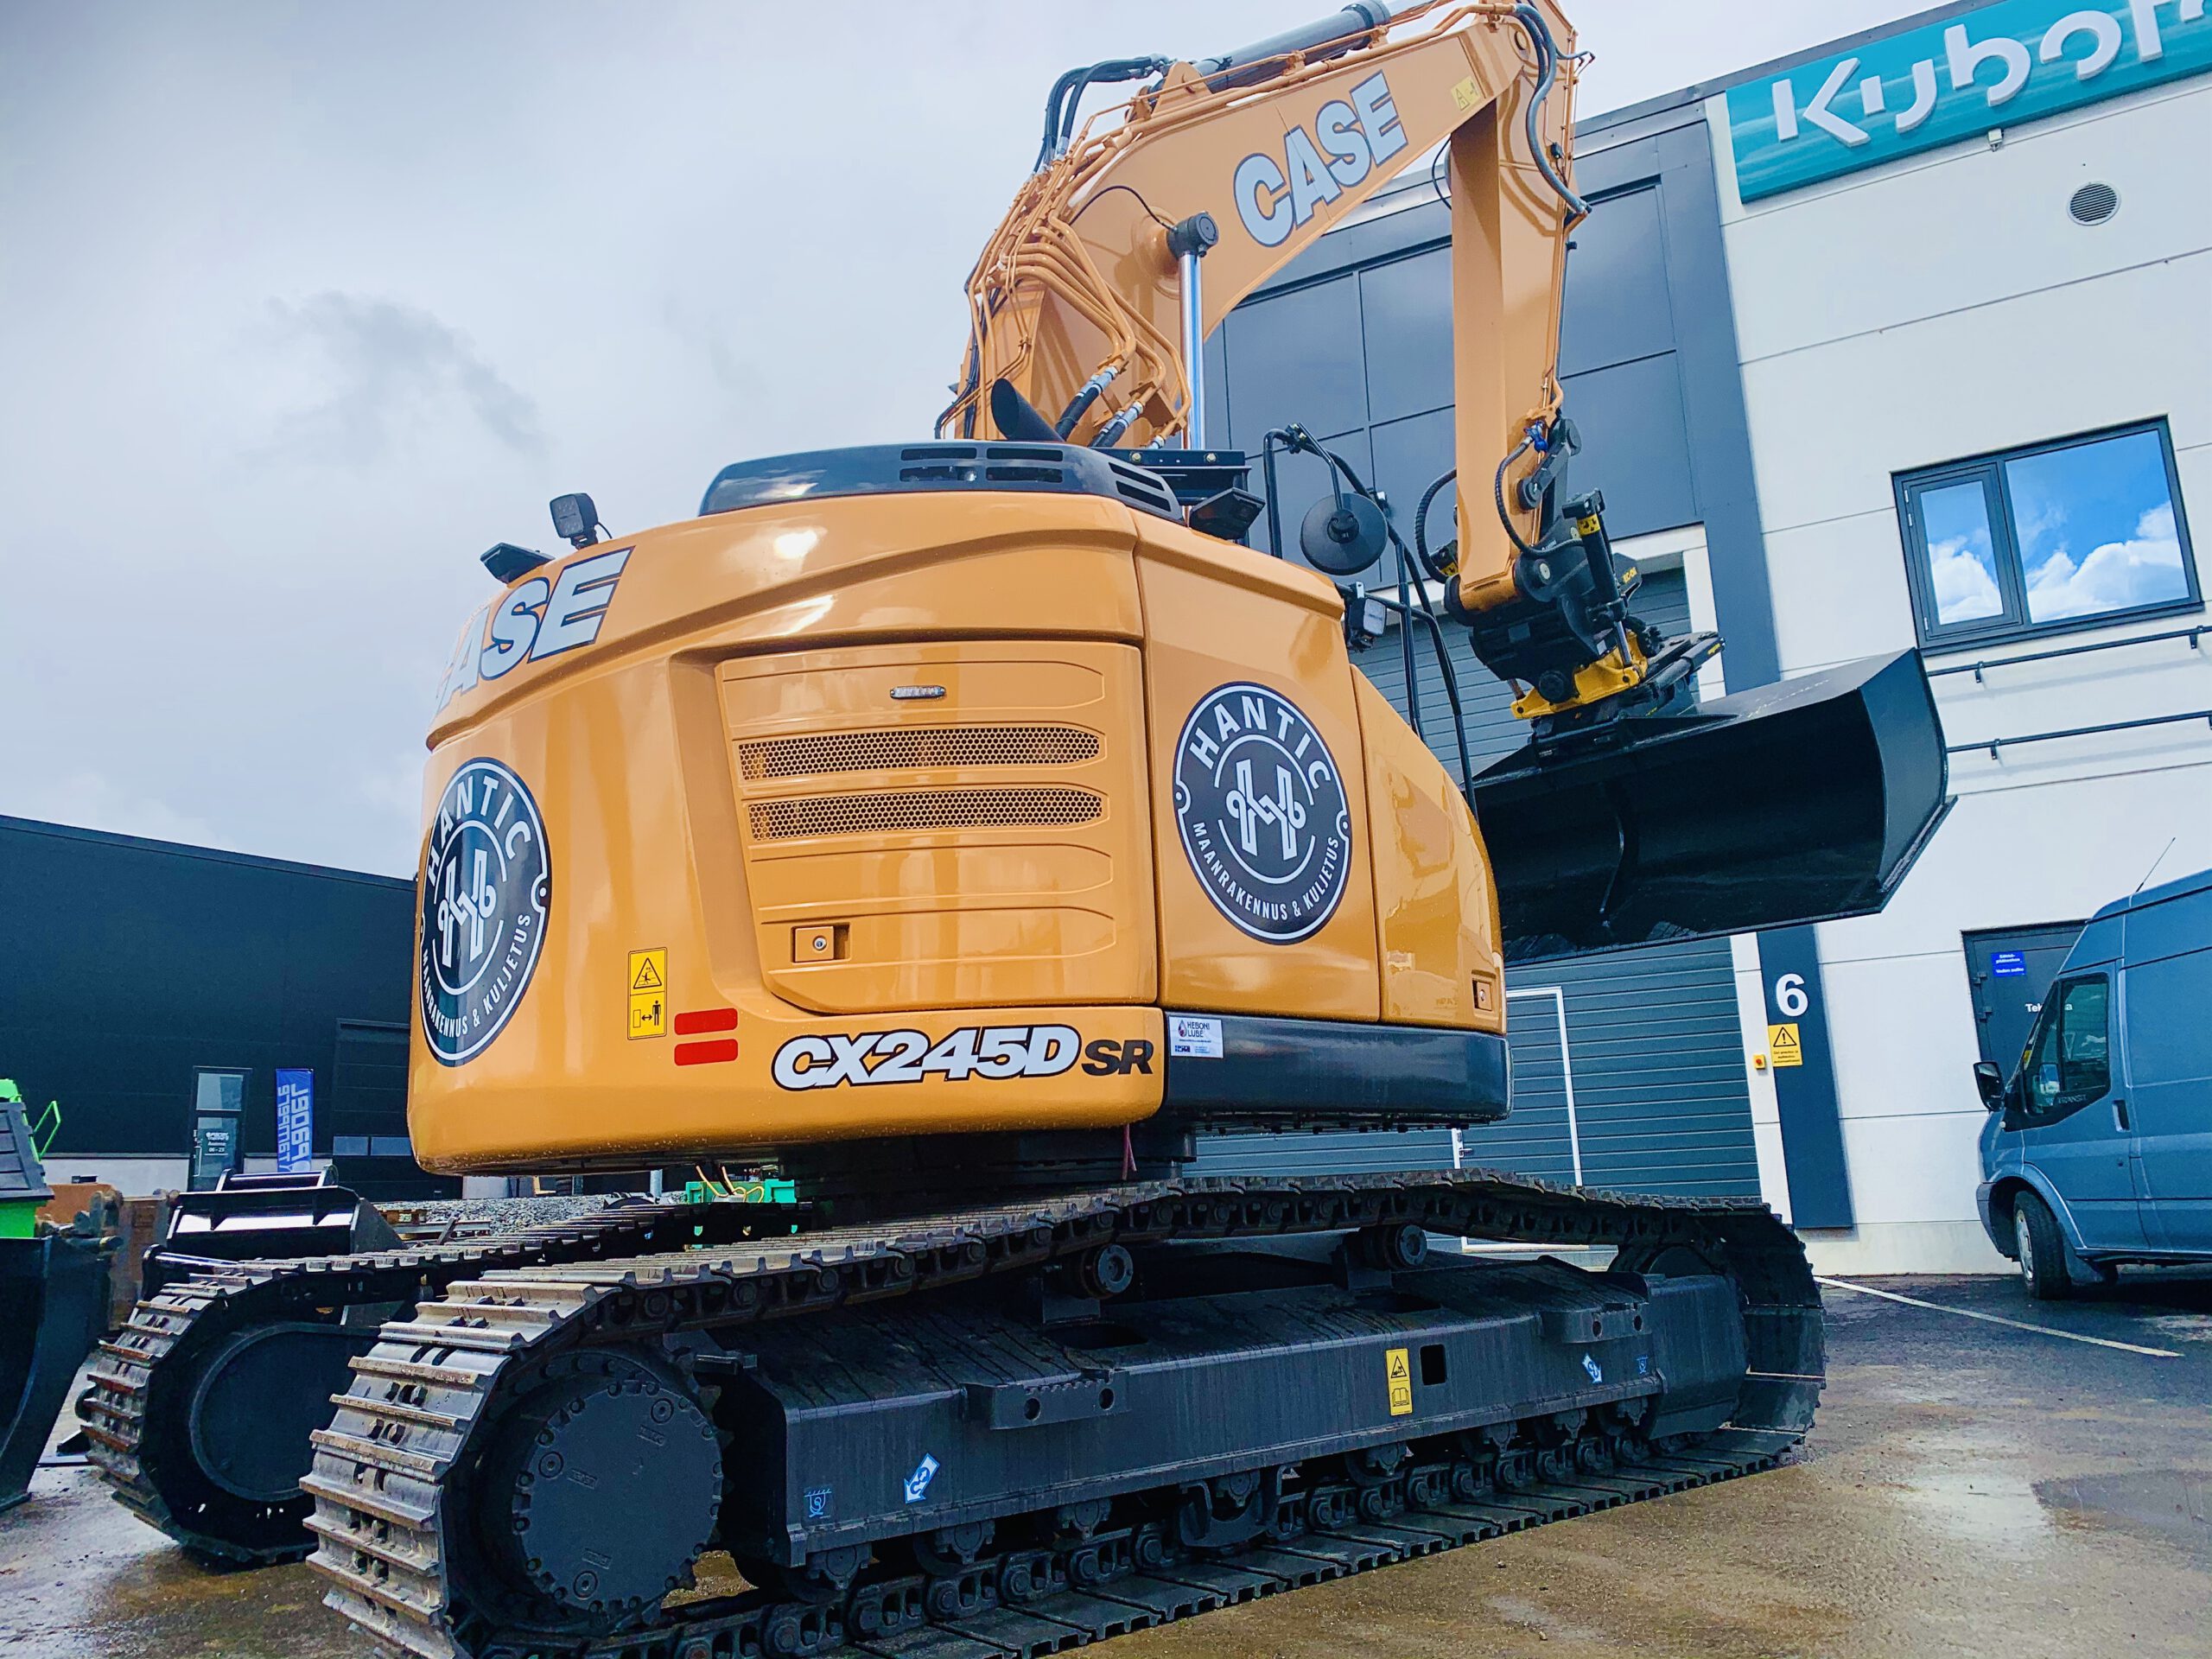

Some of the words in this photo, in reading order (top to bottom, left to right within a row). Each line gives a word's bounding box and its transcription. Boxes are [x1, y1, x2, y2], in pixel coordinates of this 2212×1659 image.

[1772, 0, 2206, 148] Kubot
[1233, 69, 1408, 248] CASE
[432, 545, 636, 716] ASE
[1189, 696, 1332, 790] HANTIC
[427, 775, 532, 887] HANTIC
[1193, 822, 1287, 921] MAANRAKENNUS
[1294, 901, 1302, 918] &
[1305, 836, 1339, 911] KULJETUS
[484, 913, 531, 1015] KULJETUS
[1776, 973, 1808, 1017] 6
[771, 1024, 1082, 1091] CX245D
[1081, 1039, 1154, 1077] SR
